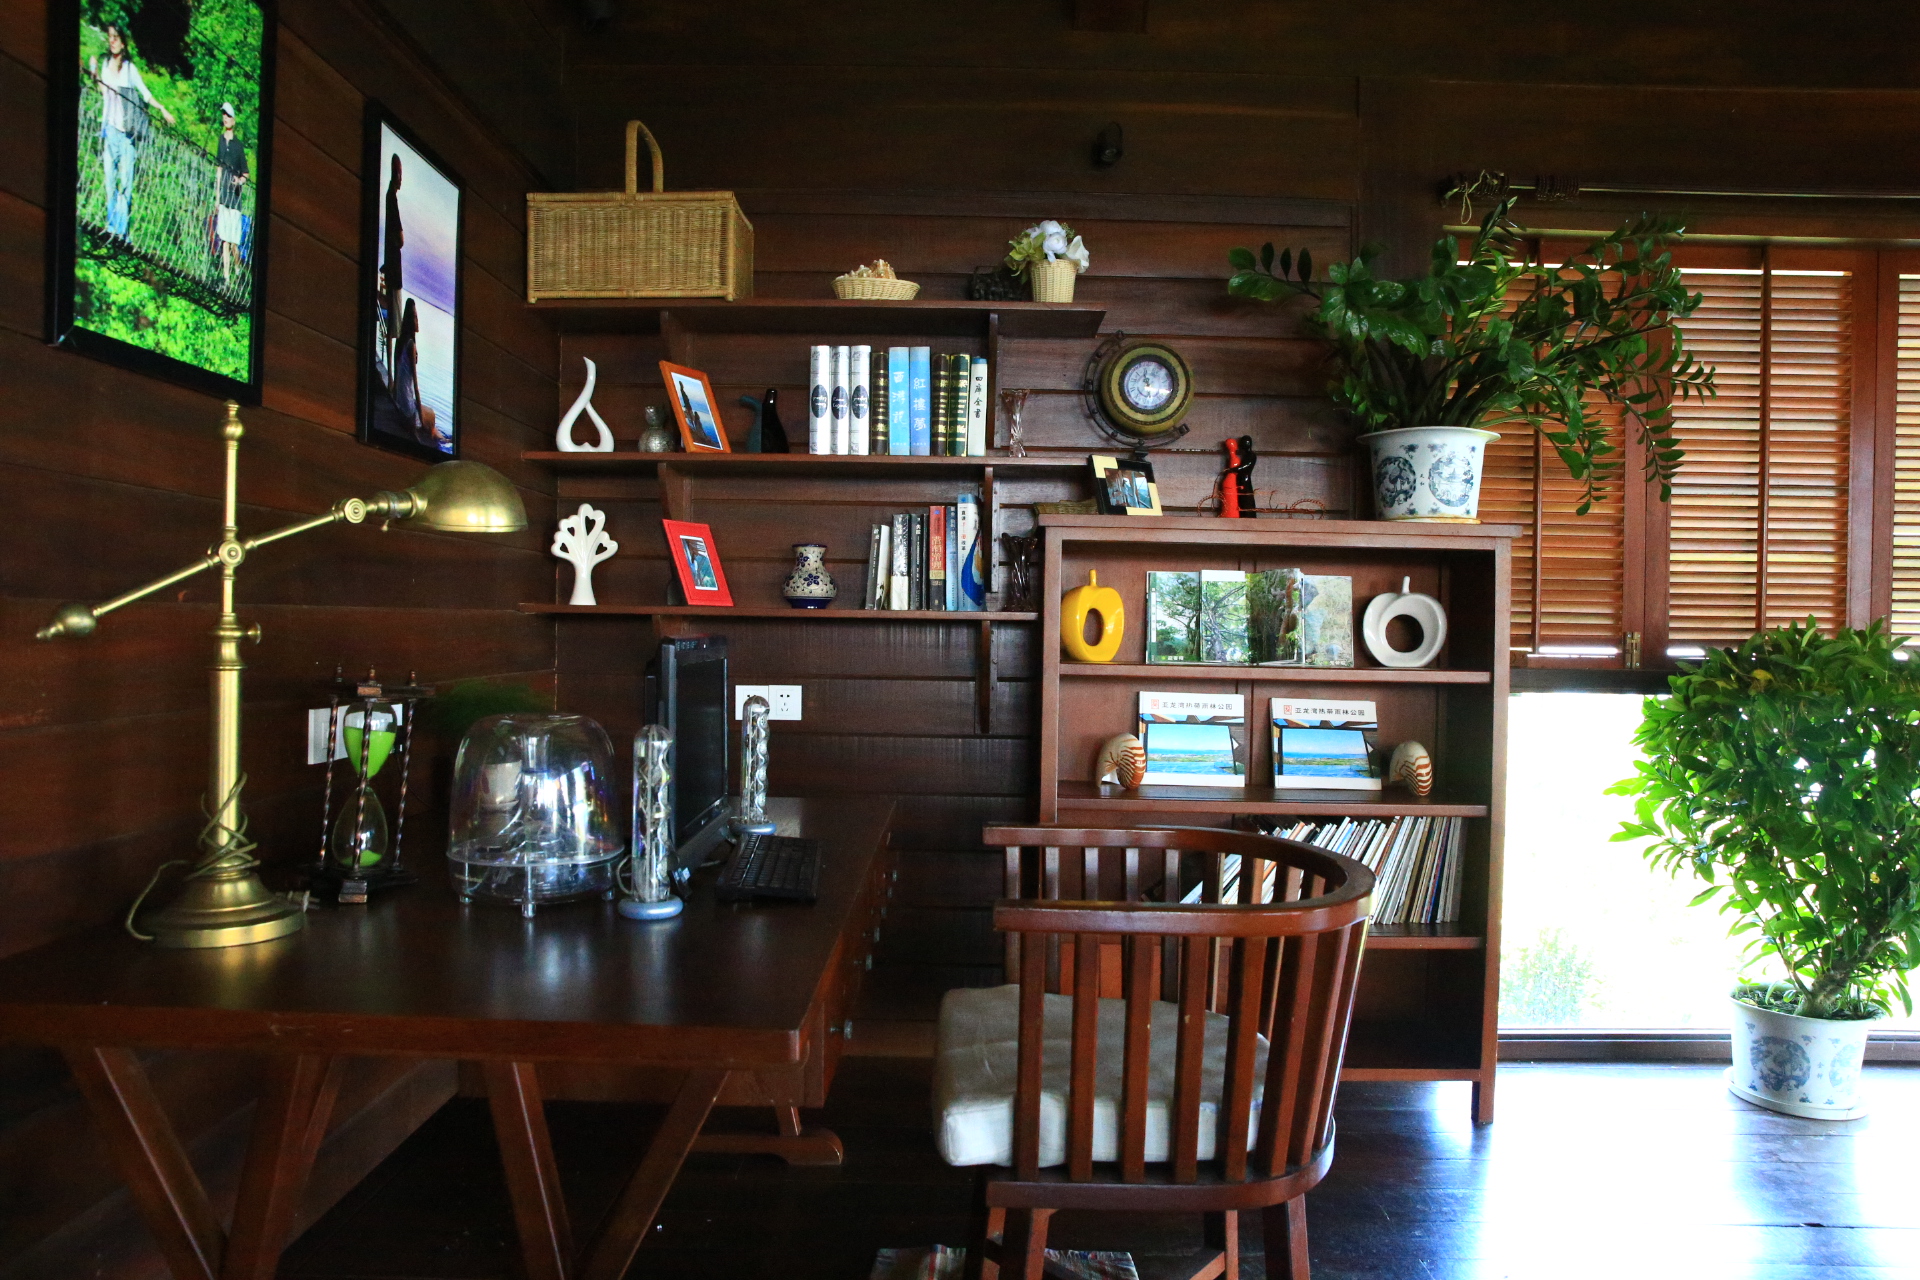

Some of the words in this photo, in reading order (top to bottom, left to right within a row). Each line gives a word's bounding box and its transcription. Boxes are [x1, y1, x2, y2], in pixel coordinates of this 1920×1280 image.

[1295, 708, 1365, 716] 亚龙湾热带雨林公园
